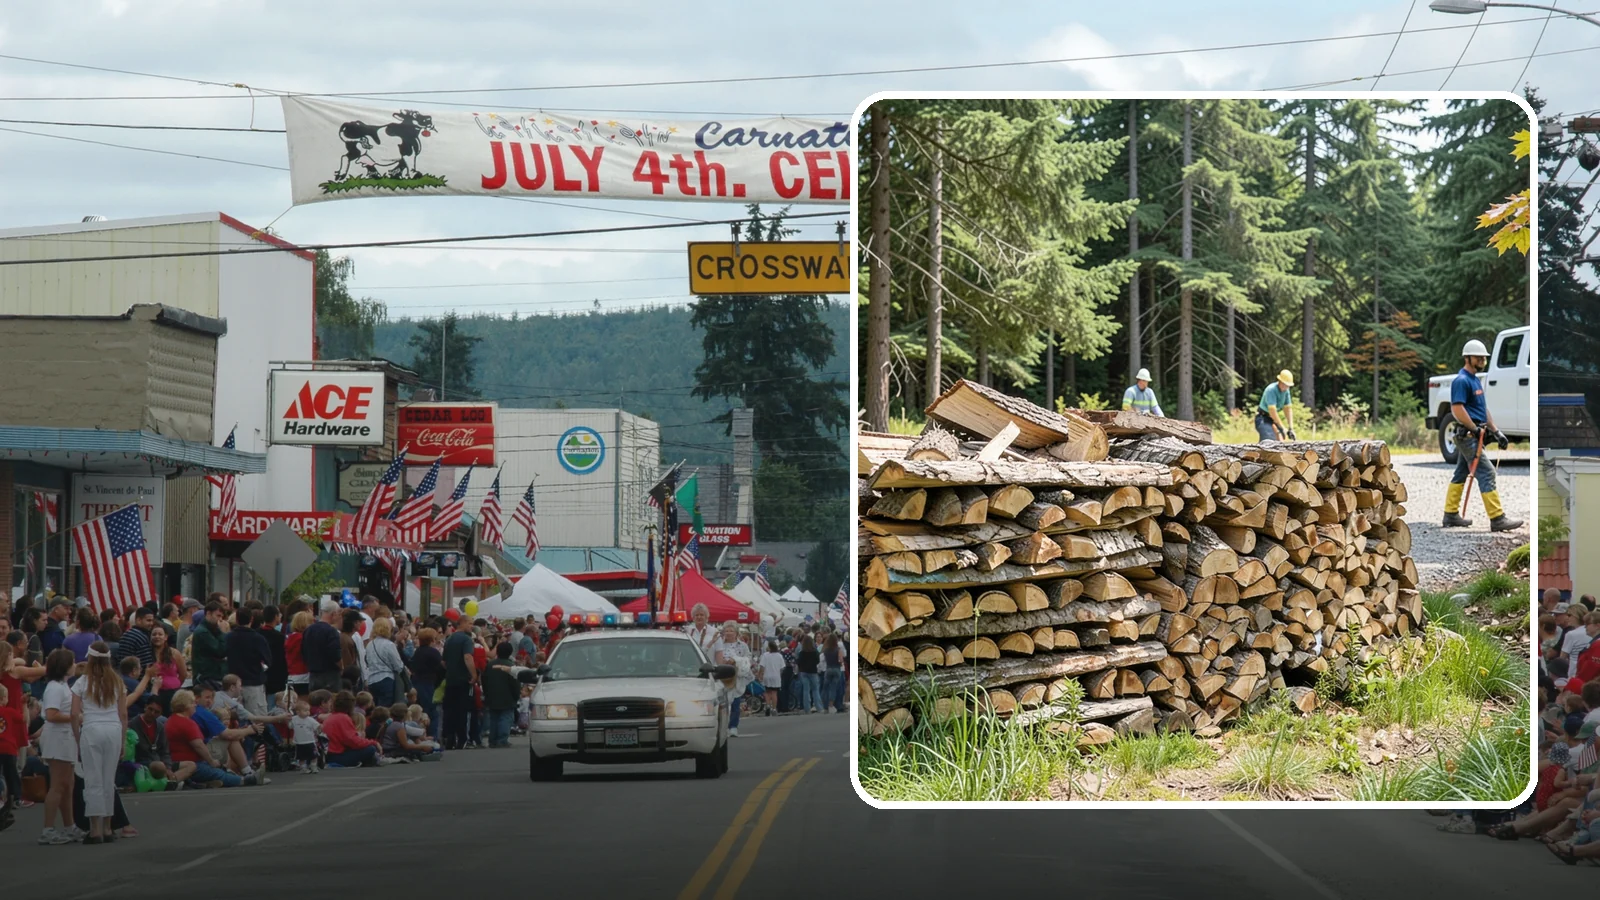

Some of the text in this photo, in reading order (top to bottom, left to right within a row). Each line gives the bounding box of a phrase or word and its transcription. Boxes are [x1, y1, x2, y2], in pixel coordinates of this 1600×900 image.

[695, 121, 850, 149] Carnat
[481, 141, 605, 193] JULY
[632, 150, 746, 198] 4th.
[697, 254, 850, 280] CROSSWA
[283, 380, 373, 420] ACE
[284, 421, 370, 437] Hardware
[83, 485, 155, 495] St. Vincent de Paul
[688, 527, 741, 535] CRNATION
